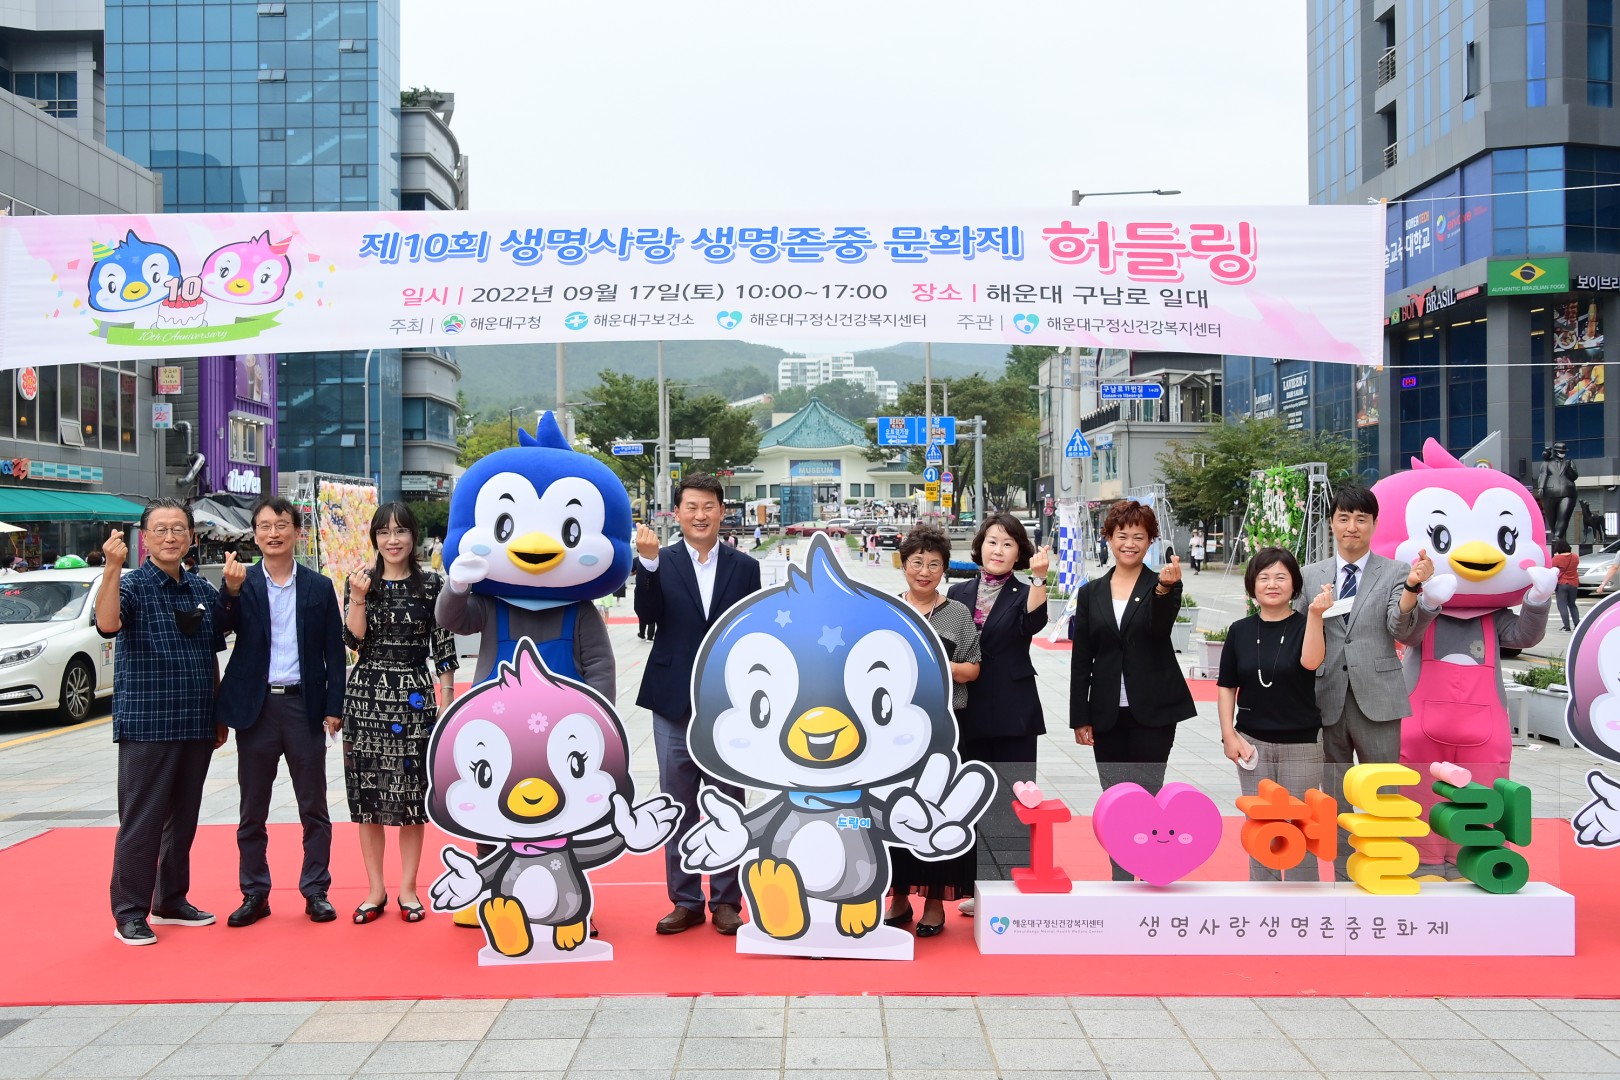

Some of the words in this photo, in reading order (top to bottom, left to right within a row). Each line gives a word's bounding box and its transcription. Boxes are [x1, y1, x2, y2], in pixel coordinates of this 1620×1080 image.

[359, 229, 491, 265] 제10회
[499, 226, 684, 267] 생명사랑
[690, 225, 878, 265] 생명존중
[884, 224, 1024, 264] 문화제
[1042, 219, 1258, 286] 허들링
[164, 276, 203, 302] 10
[402, 286, 448, 307] 일시
[471, 284, 554, 304] 2022년
[562, 283, 618, 302] 09월
[629, 282, 725, 302] 17일(토)
[735, 284, 888, 300] 10:00~17:00
[911, 282, 963, 303] 장소
[986, 283, 1063, 304] 해운대
[1072, 286, 1151, 305] 구남로
[1159, 288, 1208, 308] 일대
[1491, 285, 1520, 293] AUTHENTIC
[1522, 283, 1549, 291] BRAZILIAN
[1426, 288, 1456, 314] BRASIL
[389, 317, 424, 335] 주최
[470, 316, 541, 331] 해운대구청
[593, 312, 695, 328] 해운대구보건소
[749, 312, 927, 328] 해운대구정신건강복지센터
[956, 313, 994, 331] 주관
[1046, 316, 1222, 338] 해운대구정신건강복지센터
[162, 330, 228, 342] Anniversary
[227, 469, 262, 494] theVen
[1012, 798, 1072, 893] I
[1012, 919, 1104, 929] 해운대구정신건강복지센터
